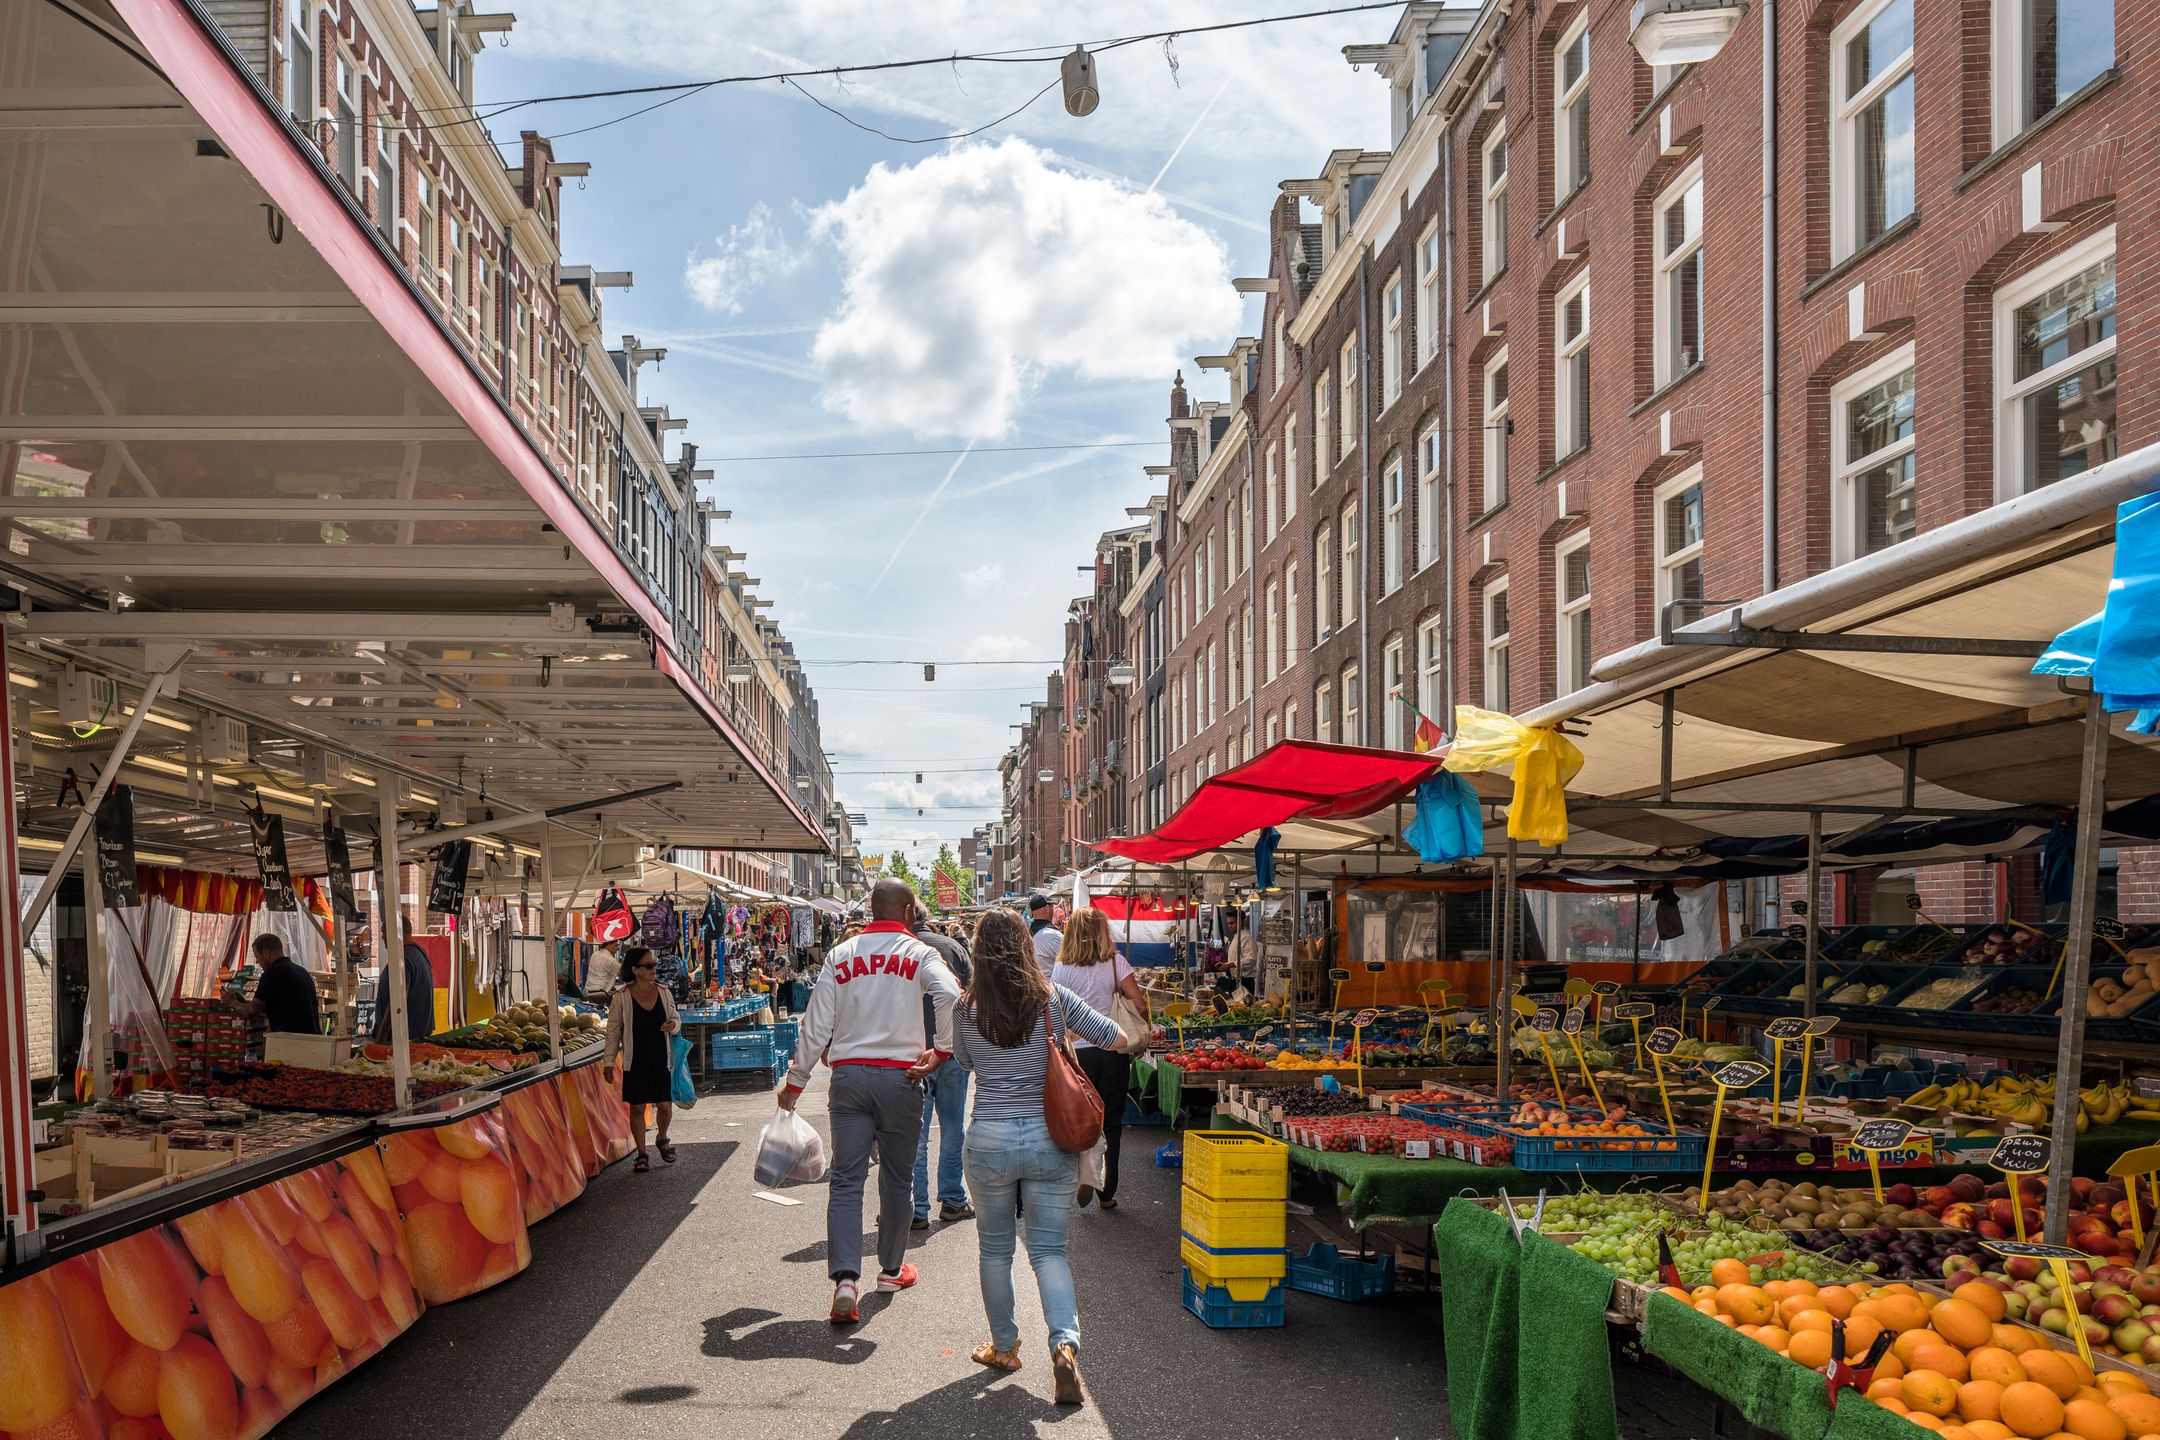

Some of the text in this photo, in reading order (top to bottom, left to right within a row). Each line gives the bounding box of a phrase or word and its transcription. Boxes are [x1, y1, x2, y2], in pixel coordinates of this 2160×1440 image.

[835, 954, 919, 985] JAPAN
[1729, 1070, 1748, 1079] 4.00
[1848, 1147, 1918, 1165] Mngo
[2012, 1148, 2042, 1159] 4.00
